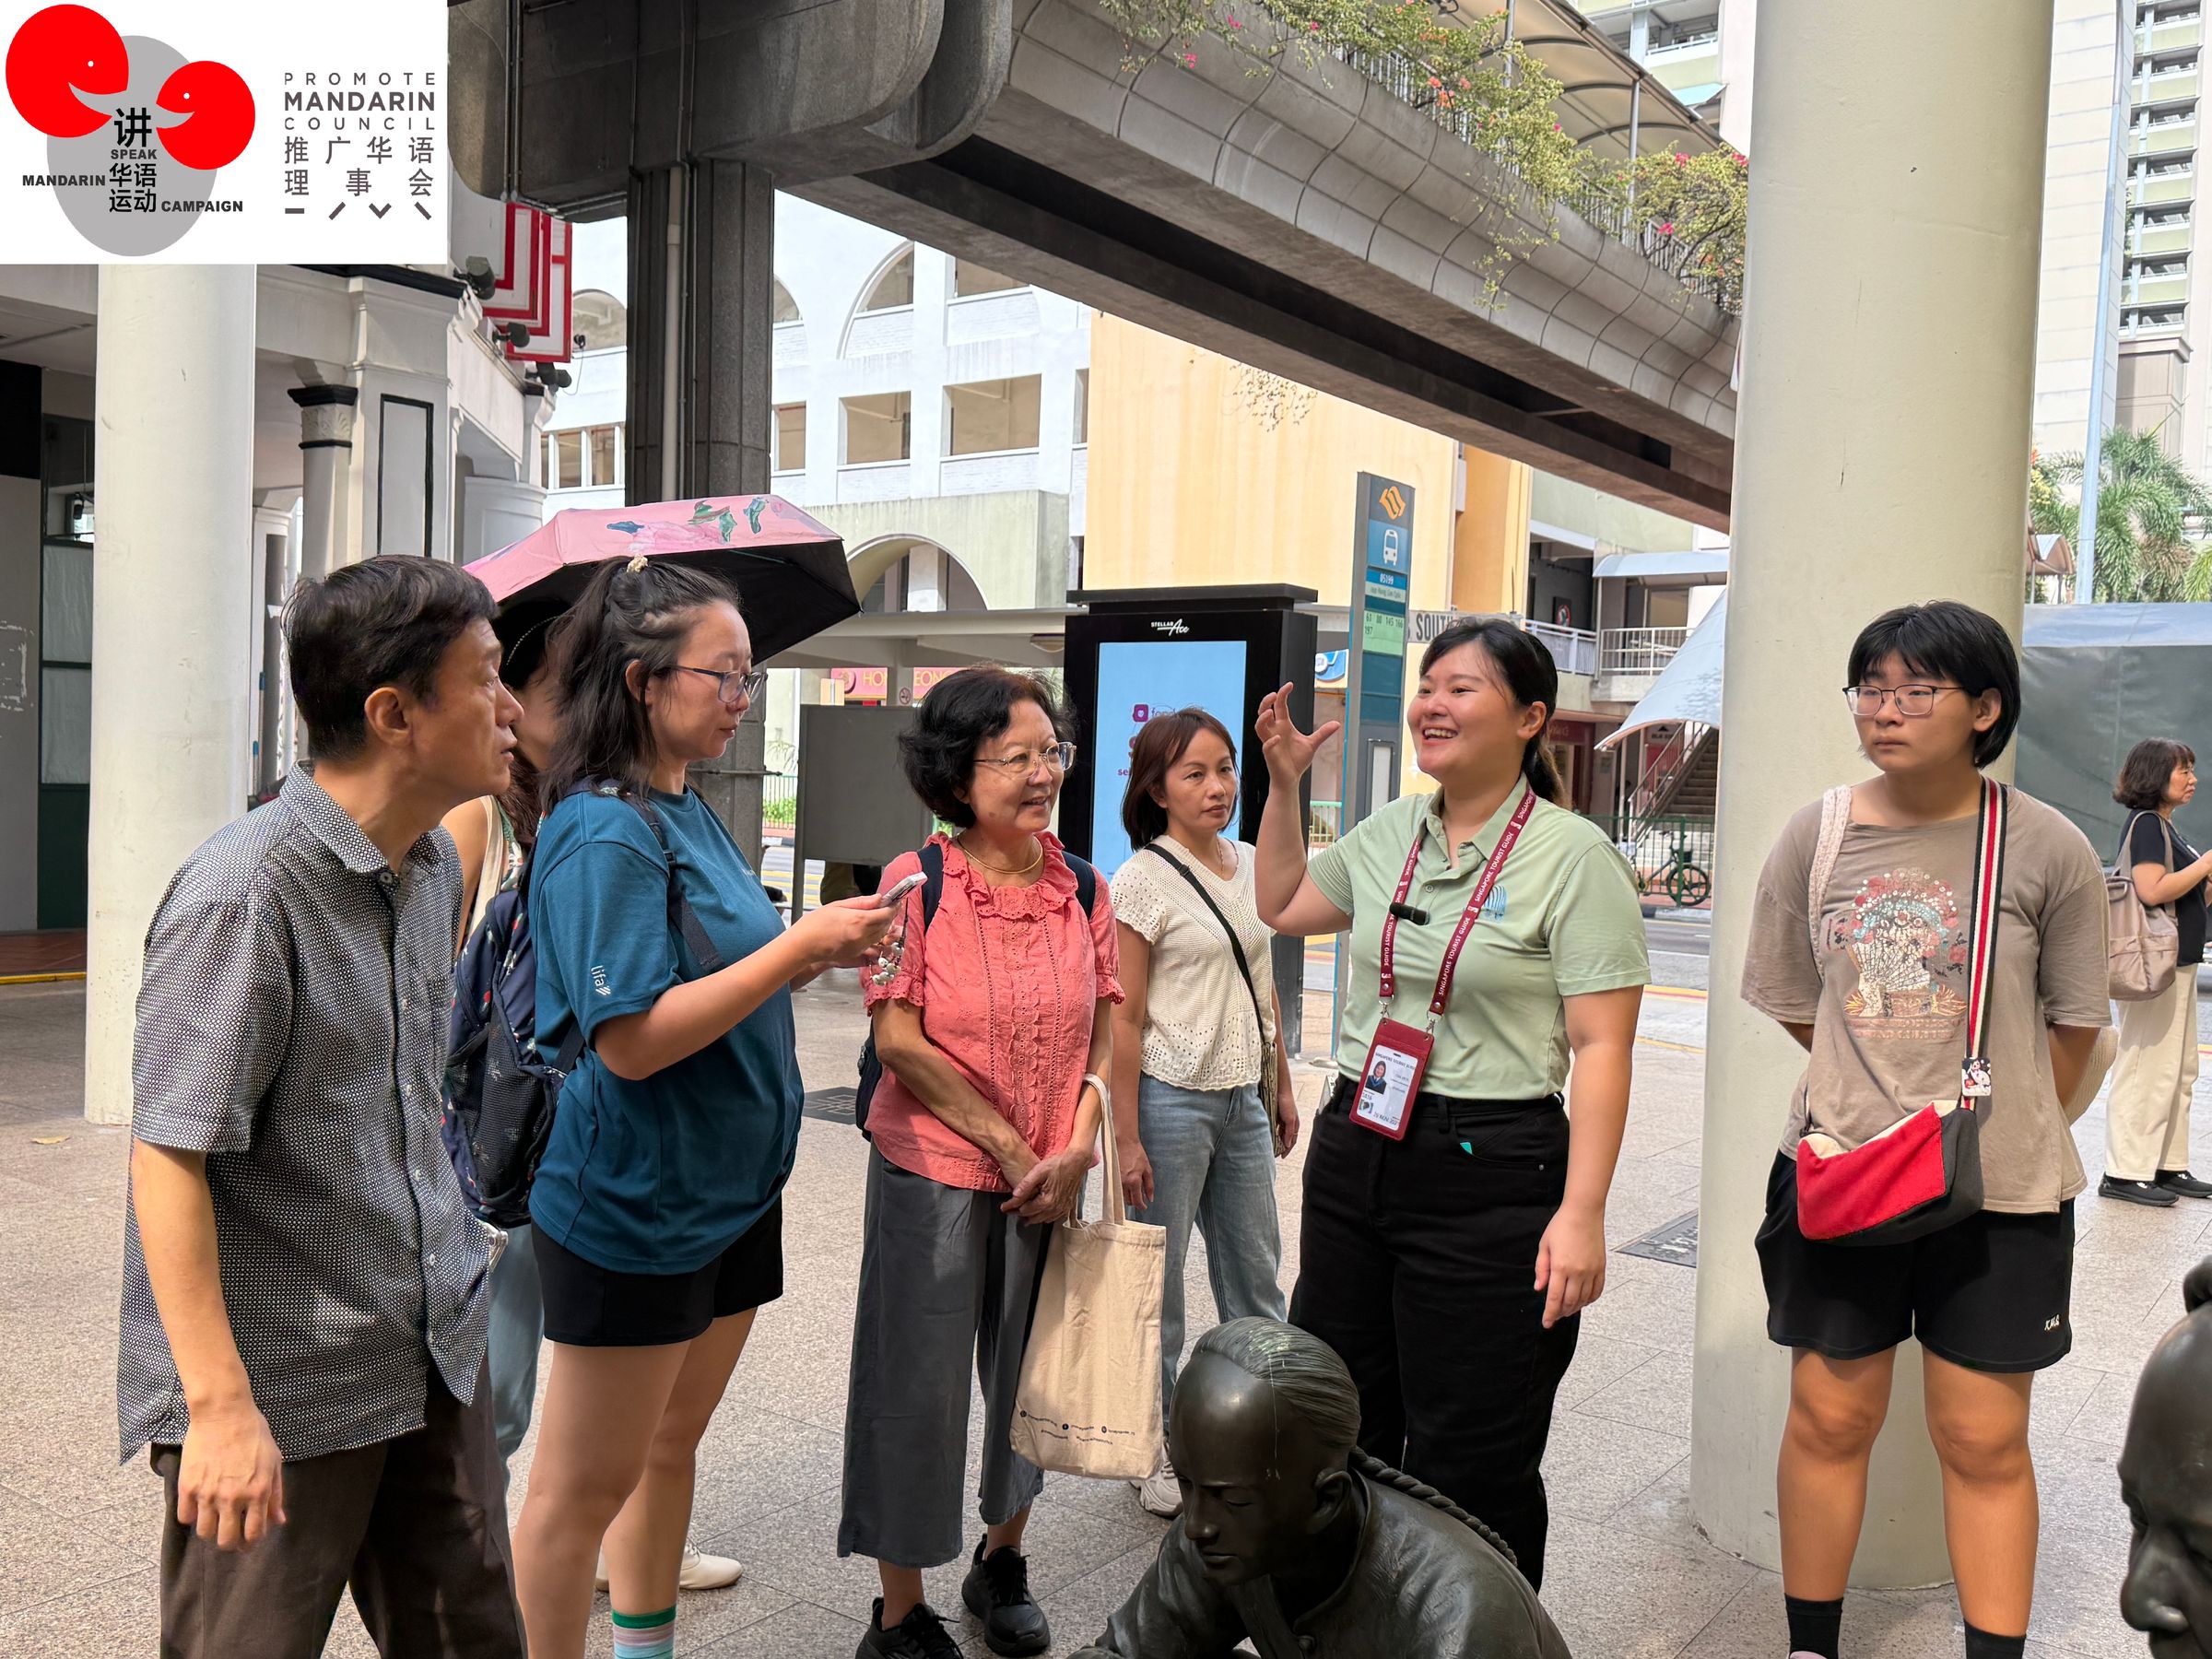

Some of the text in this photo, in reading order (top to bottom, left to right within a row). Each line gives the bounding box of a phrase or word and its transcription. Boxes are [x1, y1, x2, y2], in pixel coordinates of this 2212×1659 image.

[1169, 618, 1189, 636] Ace
[1475, 831, 1514, 902] SINGAPORE TOURIST GUIDE
[1439, 916, 1471, 996] SINGAPORE TOURIST GUIDE
